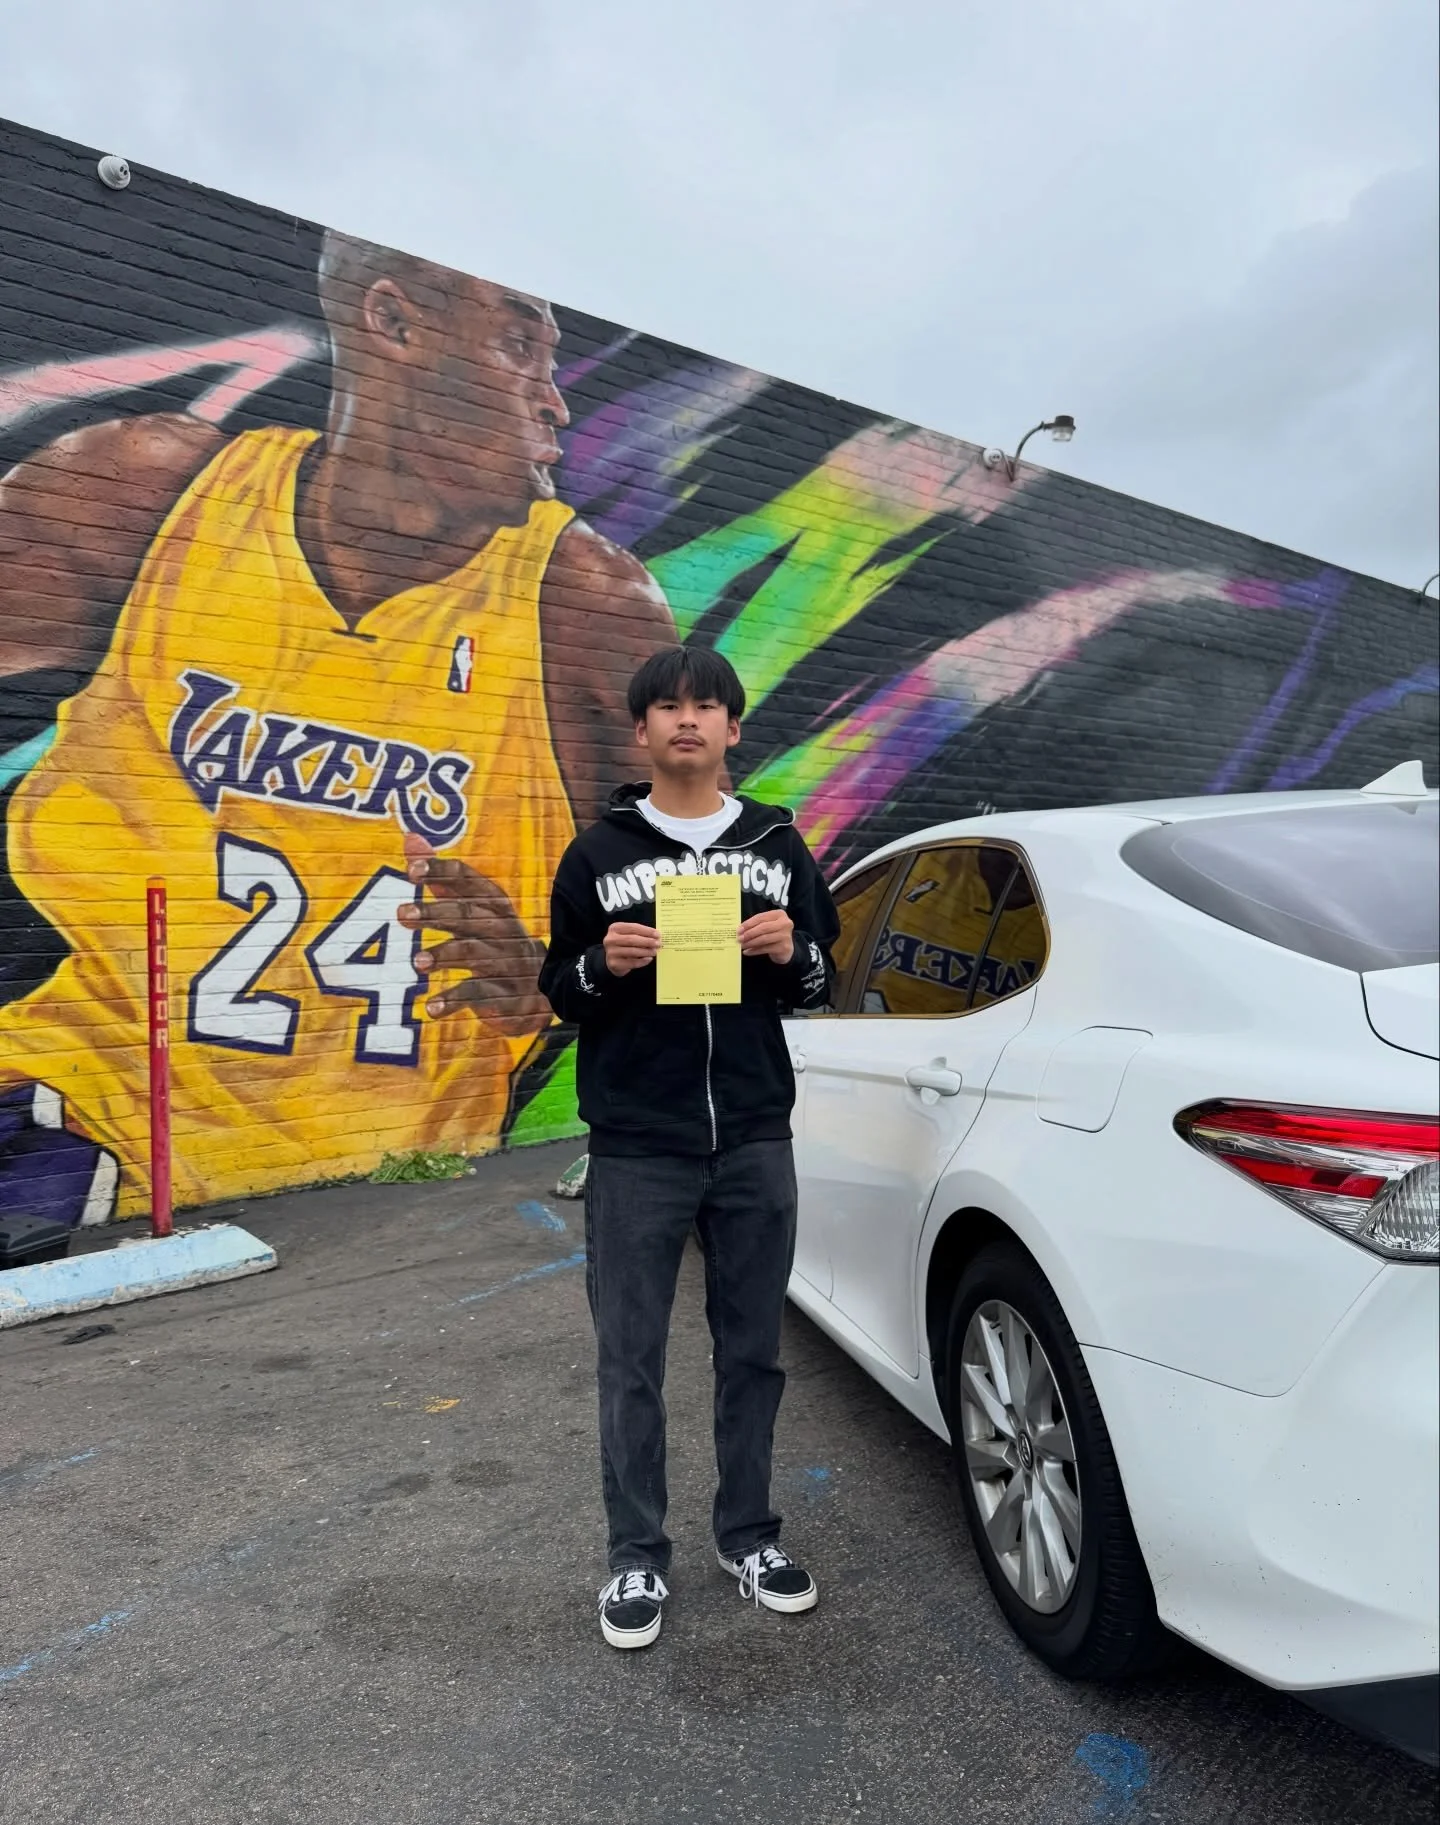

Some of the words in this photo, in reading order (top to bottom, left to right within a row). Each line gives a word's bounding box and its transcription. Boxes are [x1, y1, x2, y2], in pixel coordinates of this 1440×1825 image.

[169, 669, 475, 850] LAKERS
[153, 893, 169, 1049] LIQUOR
[188, 831, 428, 1068] 24
